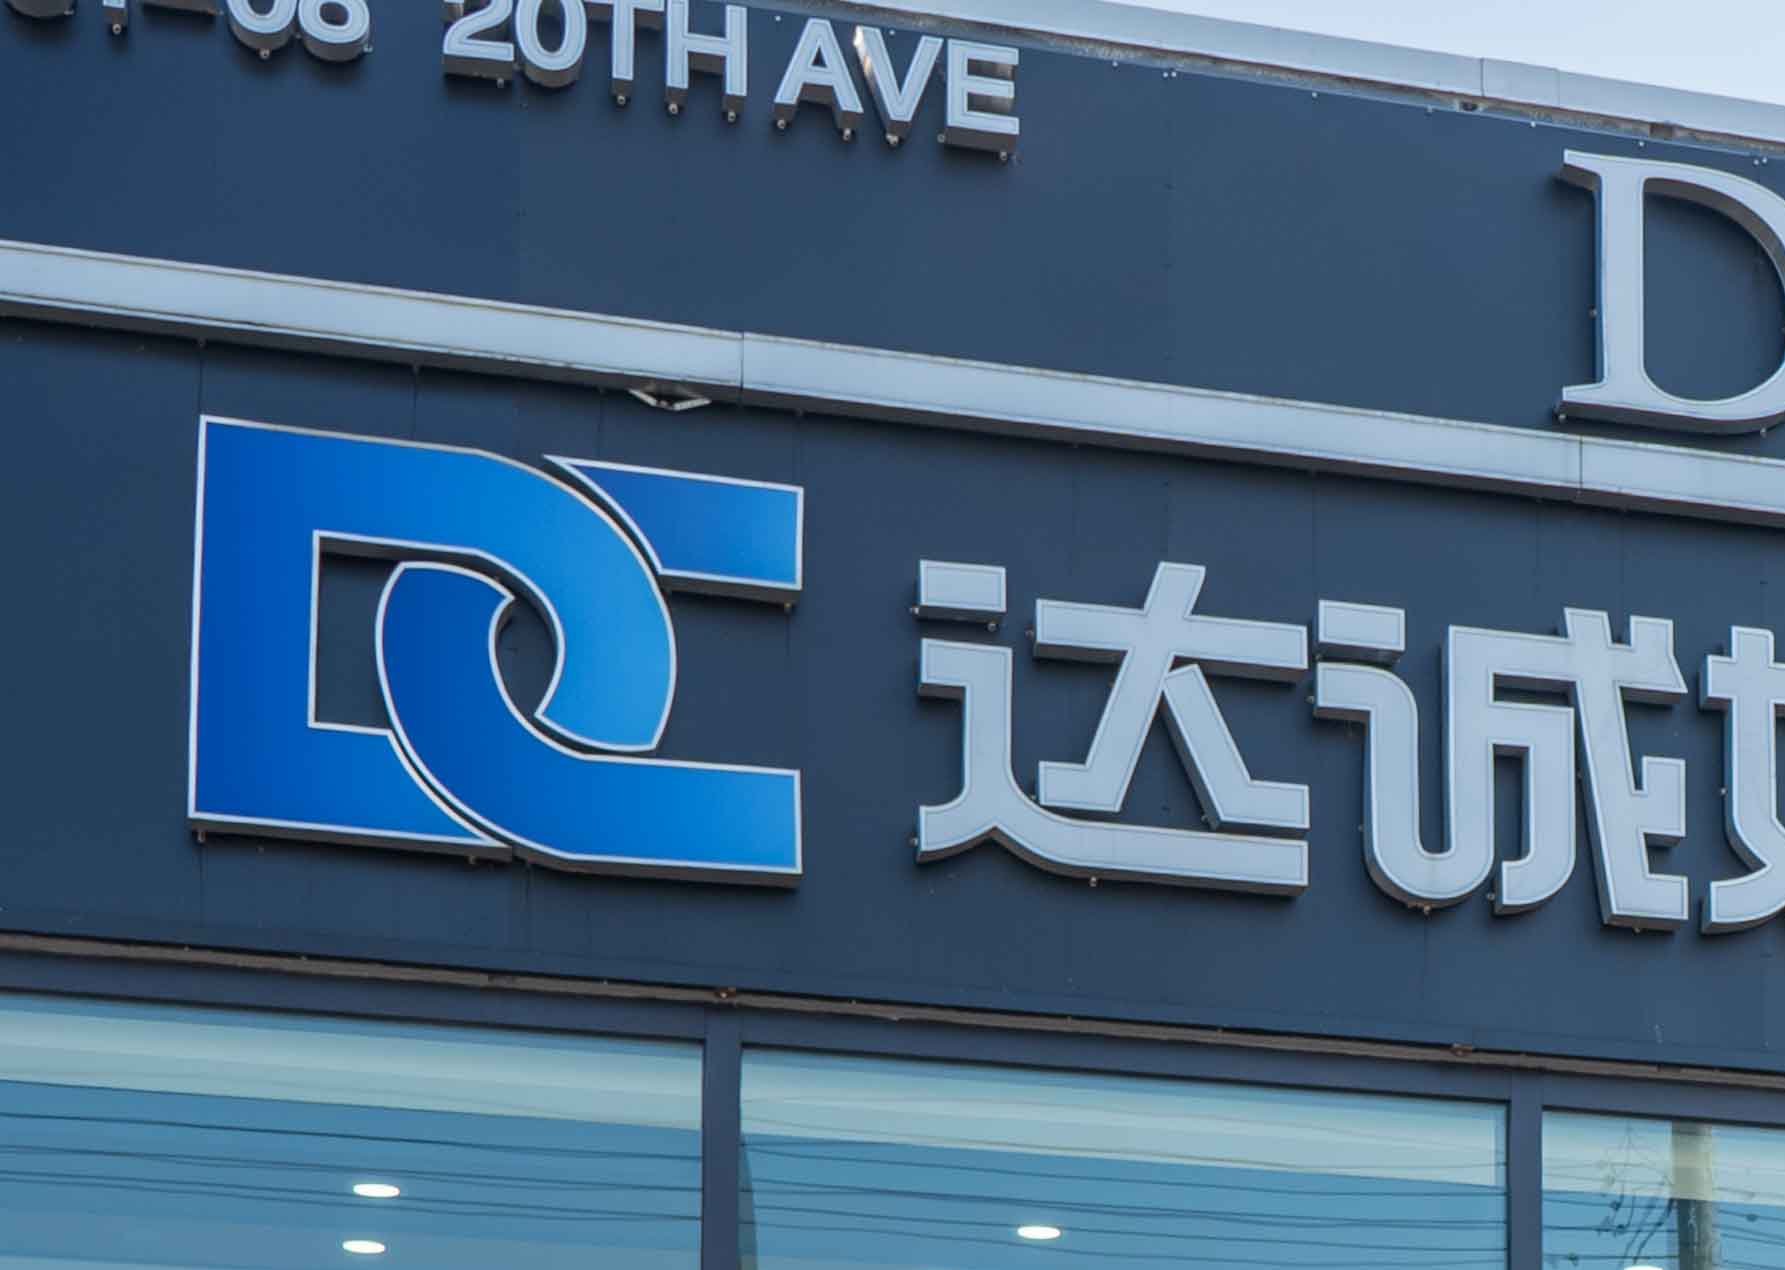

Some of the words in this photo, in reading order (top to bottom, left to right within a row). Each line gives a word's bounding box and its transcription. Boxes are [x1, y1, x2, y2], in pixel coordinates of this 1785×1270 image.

[443, 0, 747, 98] 20TH
[774, 17, 1021, 136] AVE
[190, 413, 803, 878] DC
